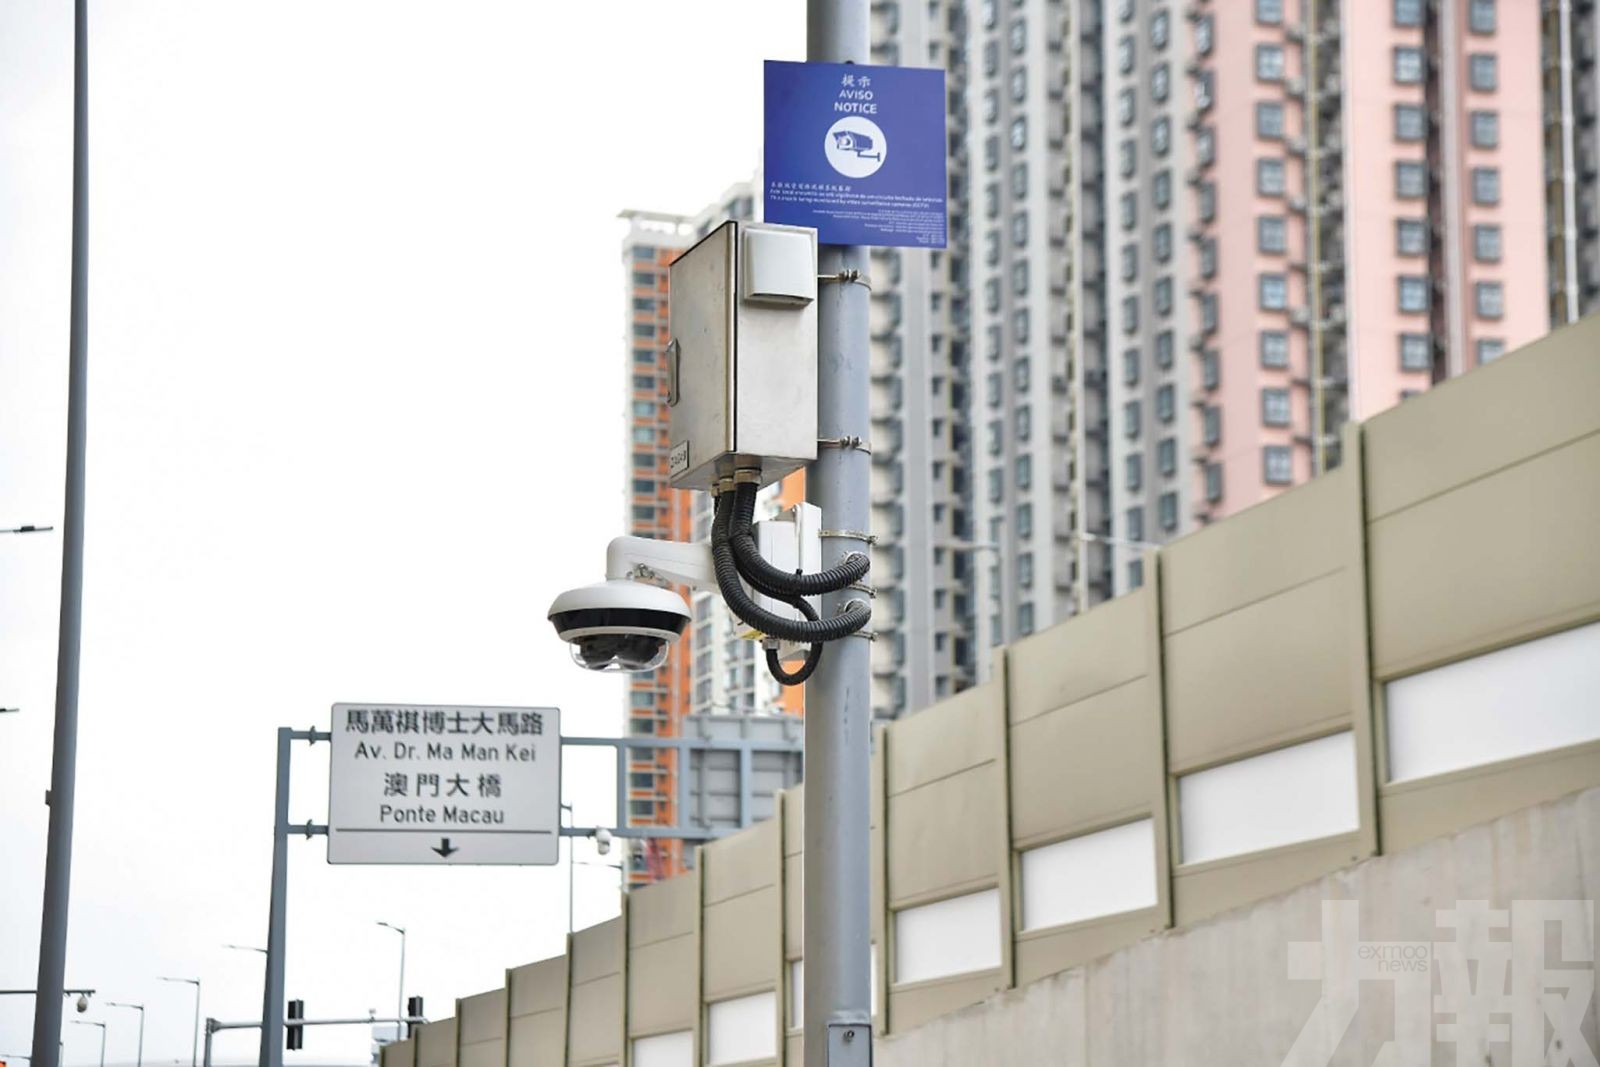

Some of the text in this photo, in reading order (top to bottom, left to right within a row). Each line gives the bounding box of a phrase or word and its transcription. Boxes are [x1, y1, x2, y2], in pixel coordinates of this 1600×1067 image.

[839, 89, 873, 101] AVISO
[834, 101, 878, 114] NOTICE
[346, 709, 543, 737] 馬萬祺博士大馬路
[354, 742, 536, 762] Av. Dr. Ma Man Kei
[383, 773, 502, 799] 澳門大橋
[379, 805, 504, 825] Ponte Macau
